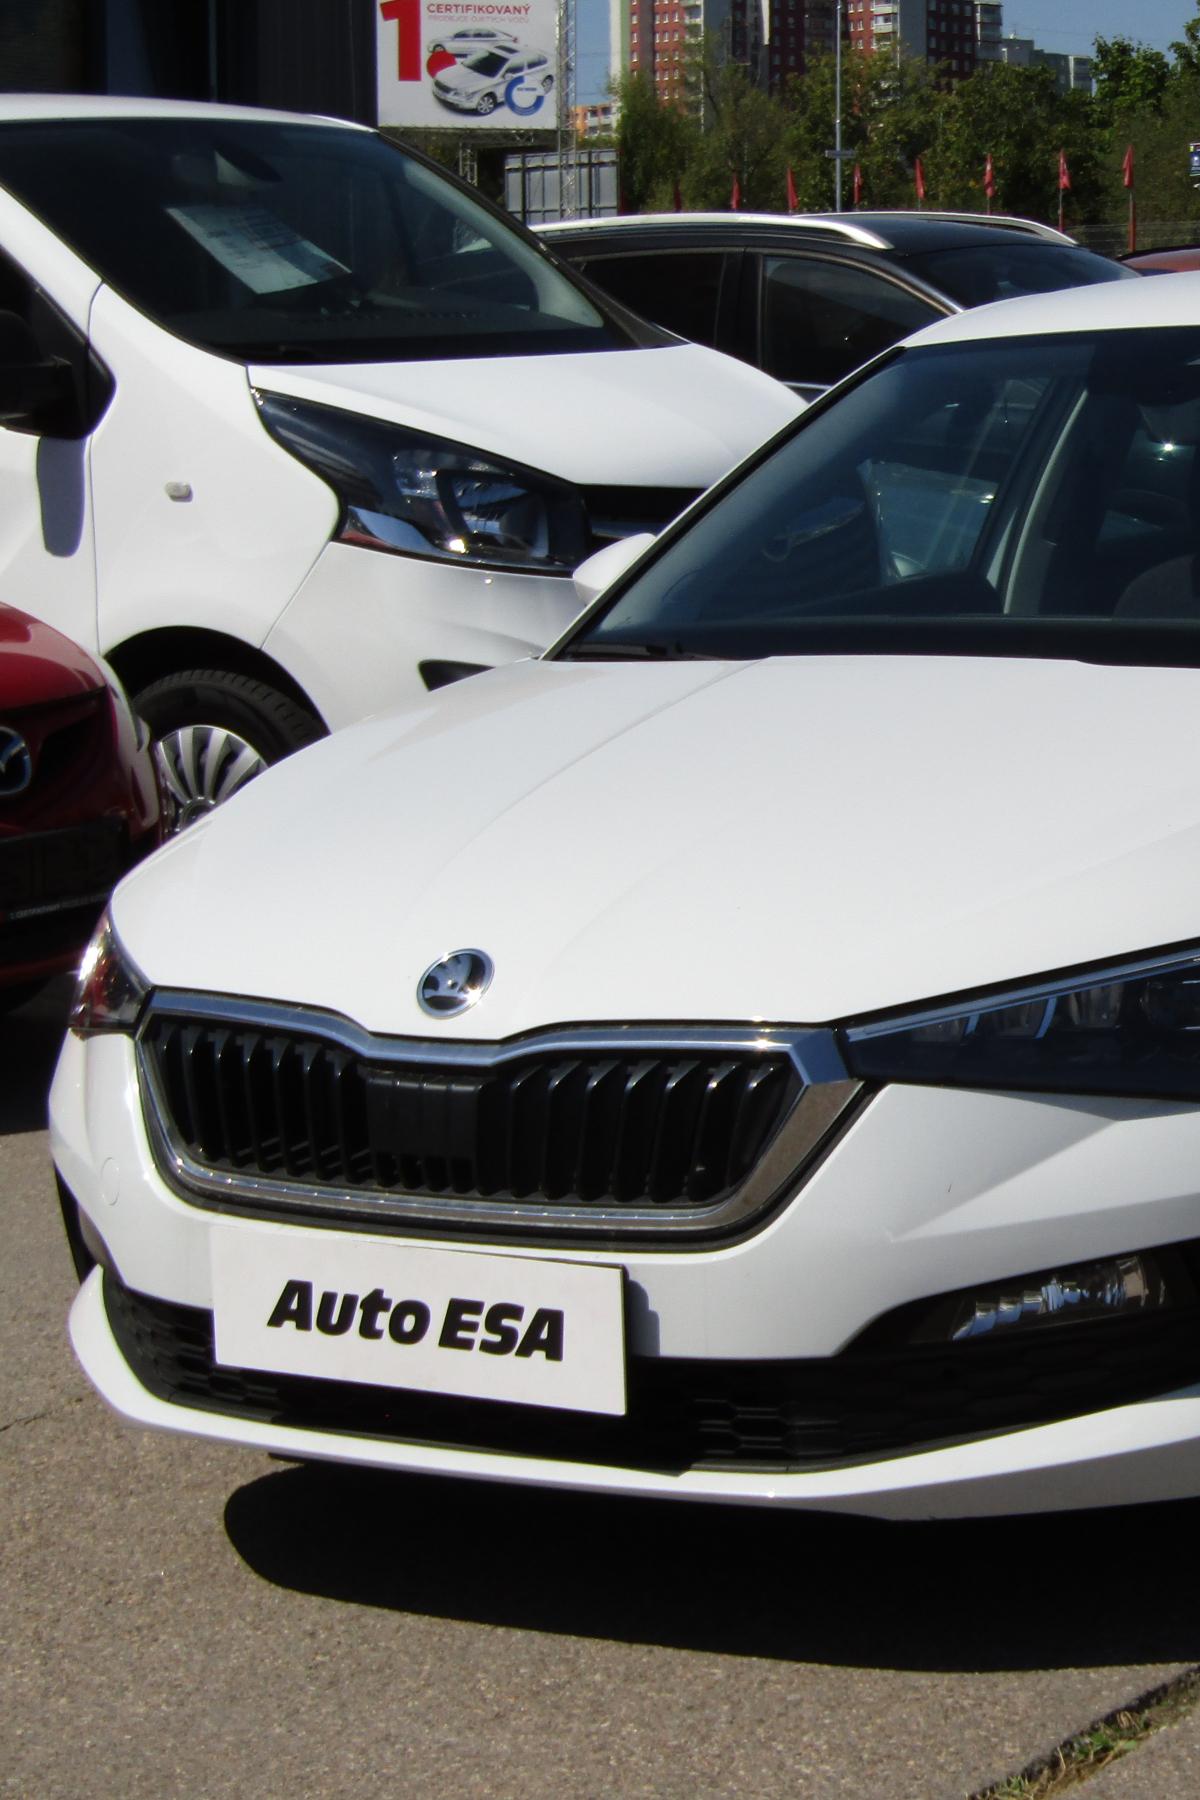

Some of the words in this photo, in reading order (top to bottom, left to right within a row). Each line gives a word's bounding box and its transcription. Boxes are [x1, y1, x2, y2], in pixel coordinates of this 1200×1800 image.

[426, 3, 531, 15] CERTIFIKOVANÝ
[266, 1279, 431, 1345] Auto
[438, 1298, 566, 1362] ESA
